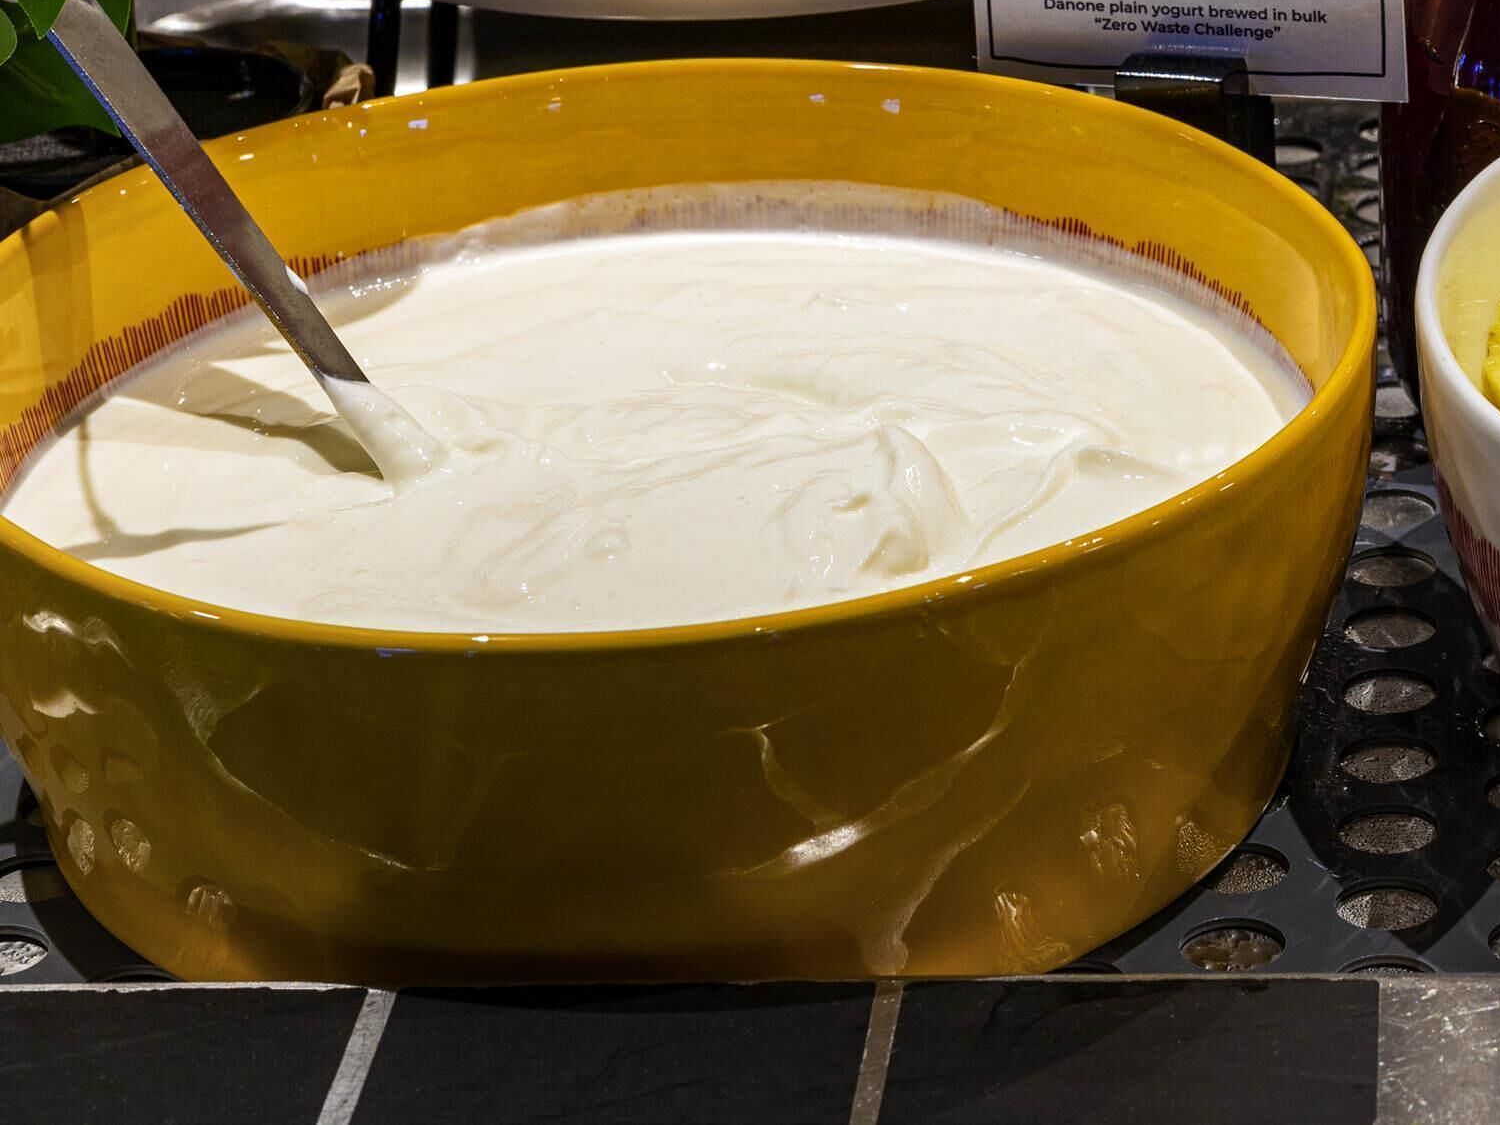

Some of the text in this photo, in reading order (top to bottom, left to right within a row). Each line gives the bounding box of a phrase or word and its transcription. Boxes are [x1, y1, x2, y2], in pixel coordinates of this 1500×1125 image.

[1109, 0, 1148, 19] plain
[1151, 5, 1204, 22] yogurt
[1208, 5, 1268, 21] brewed
[1272, 9, 1287, 22] in
[1292, 10, 1328, 24] bulk
[1141, 20, 1190, 35] Waste
